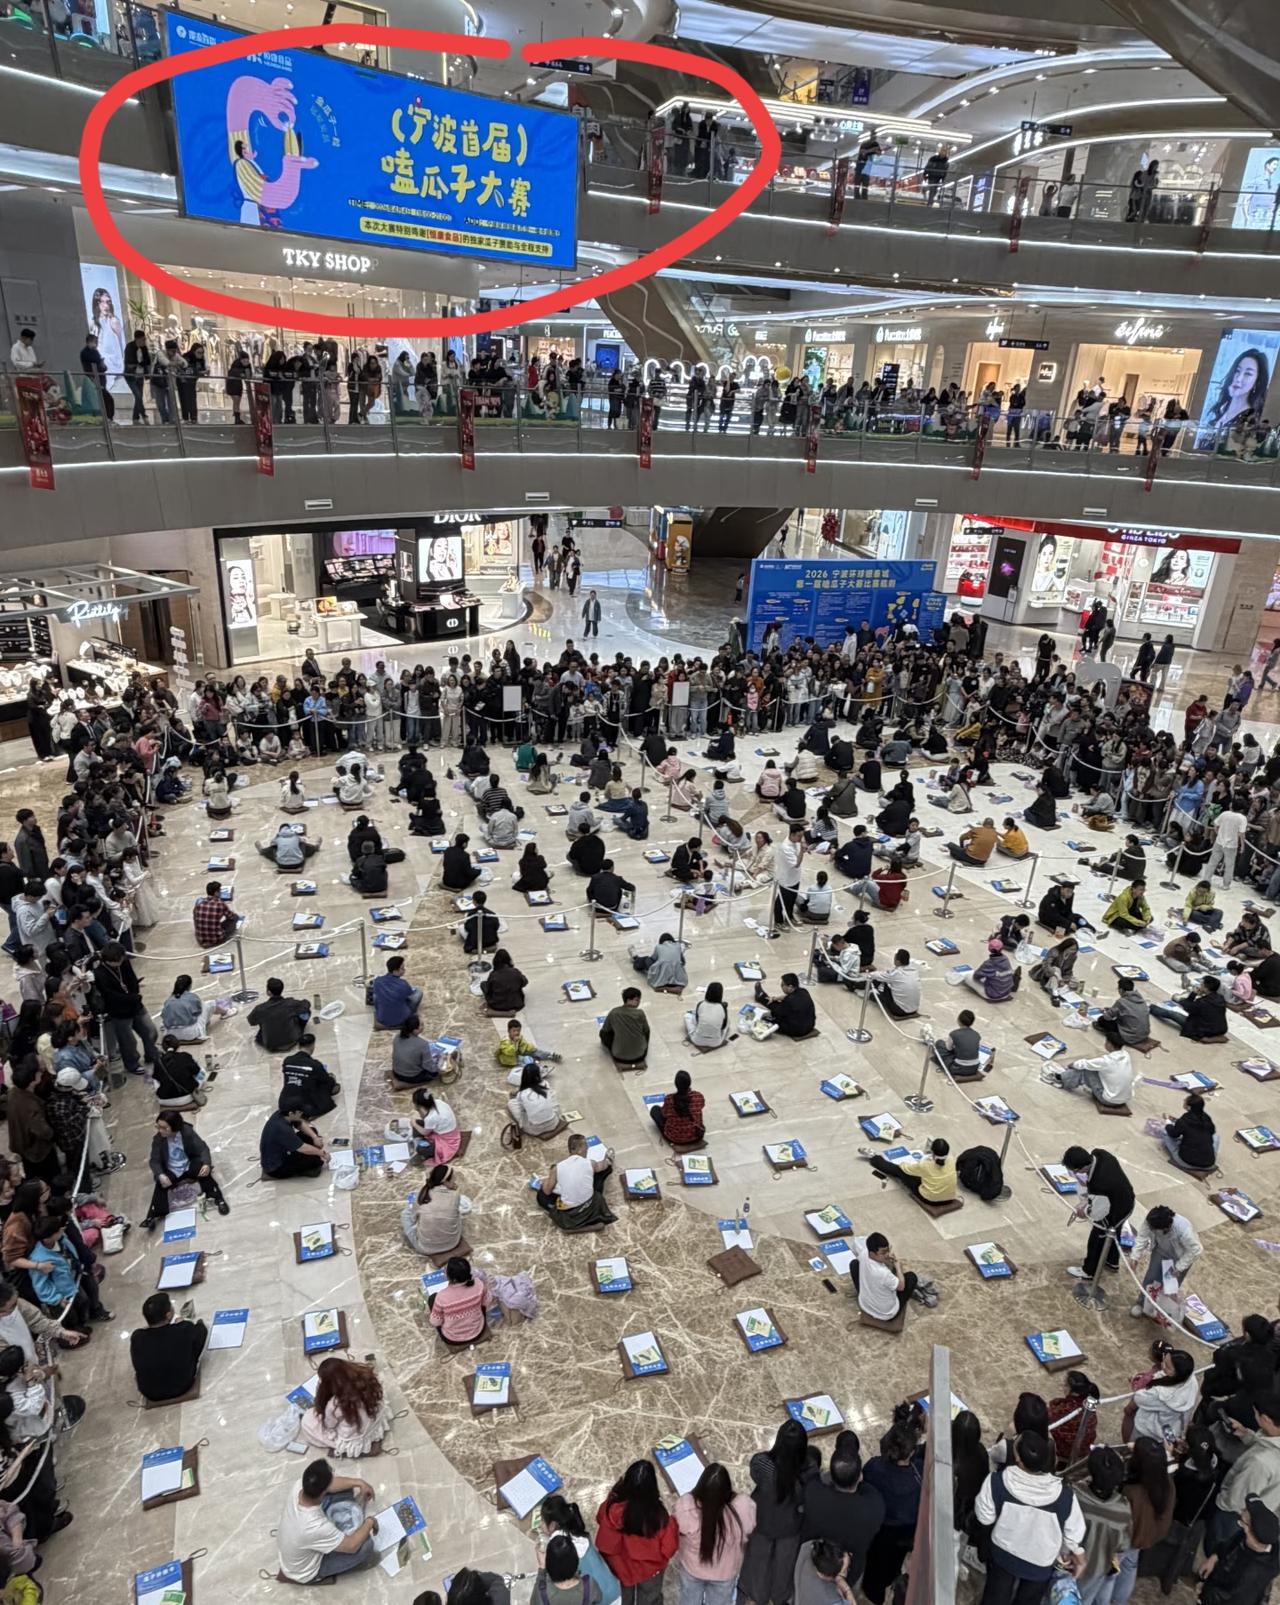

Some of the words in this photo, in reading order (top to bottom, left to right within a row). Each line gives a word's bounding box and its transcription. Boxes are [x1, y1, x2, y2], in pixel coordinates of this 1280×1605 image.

[380, 146, 531, 217] 嗑瓜子大赛
[282, 248, 322, 267] TKY
[325, 252, 371, 273] SHOP
[1121, 534, 1143, 542] GINZA
[1144, 536, 1167, 544] TOKYO
[805, 569, 828, 578] 2026
